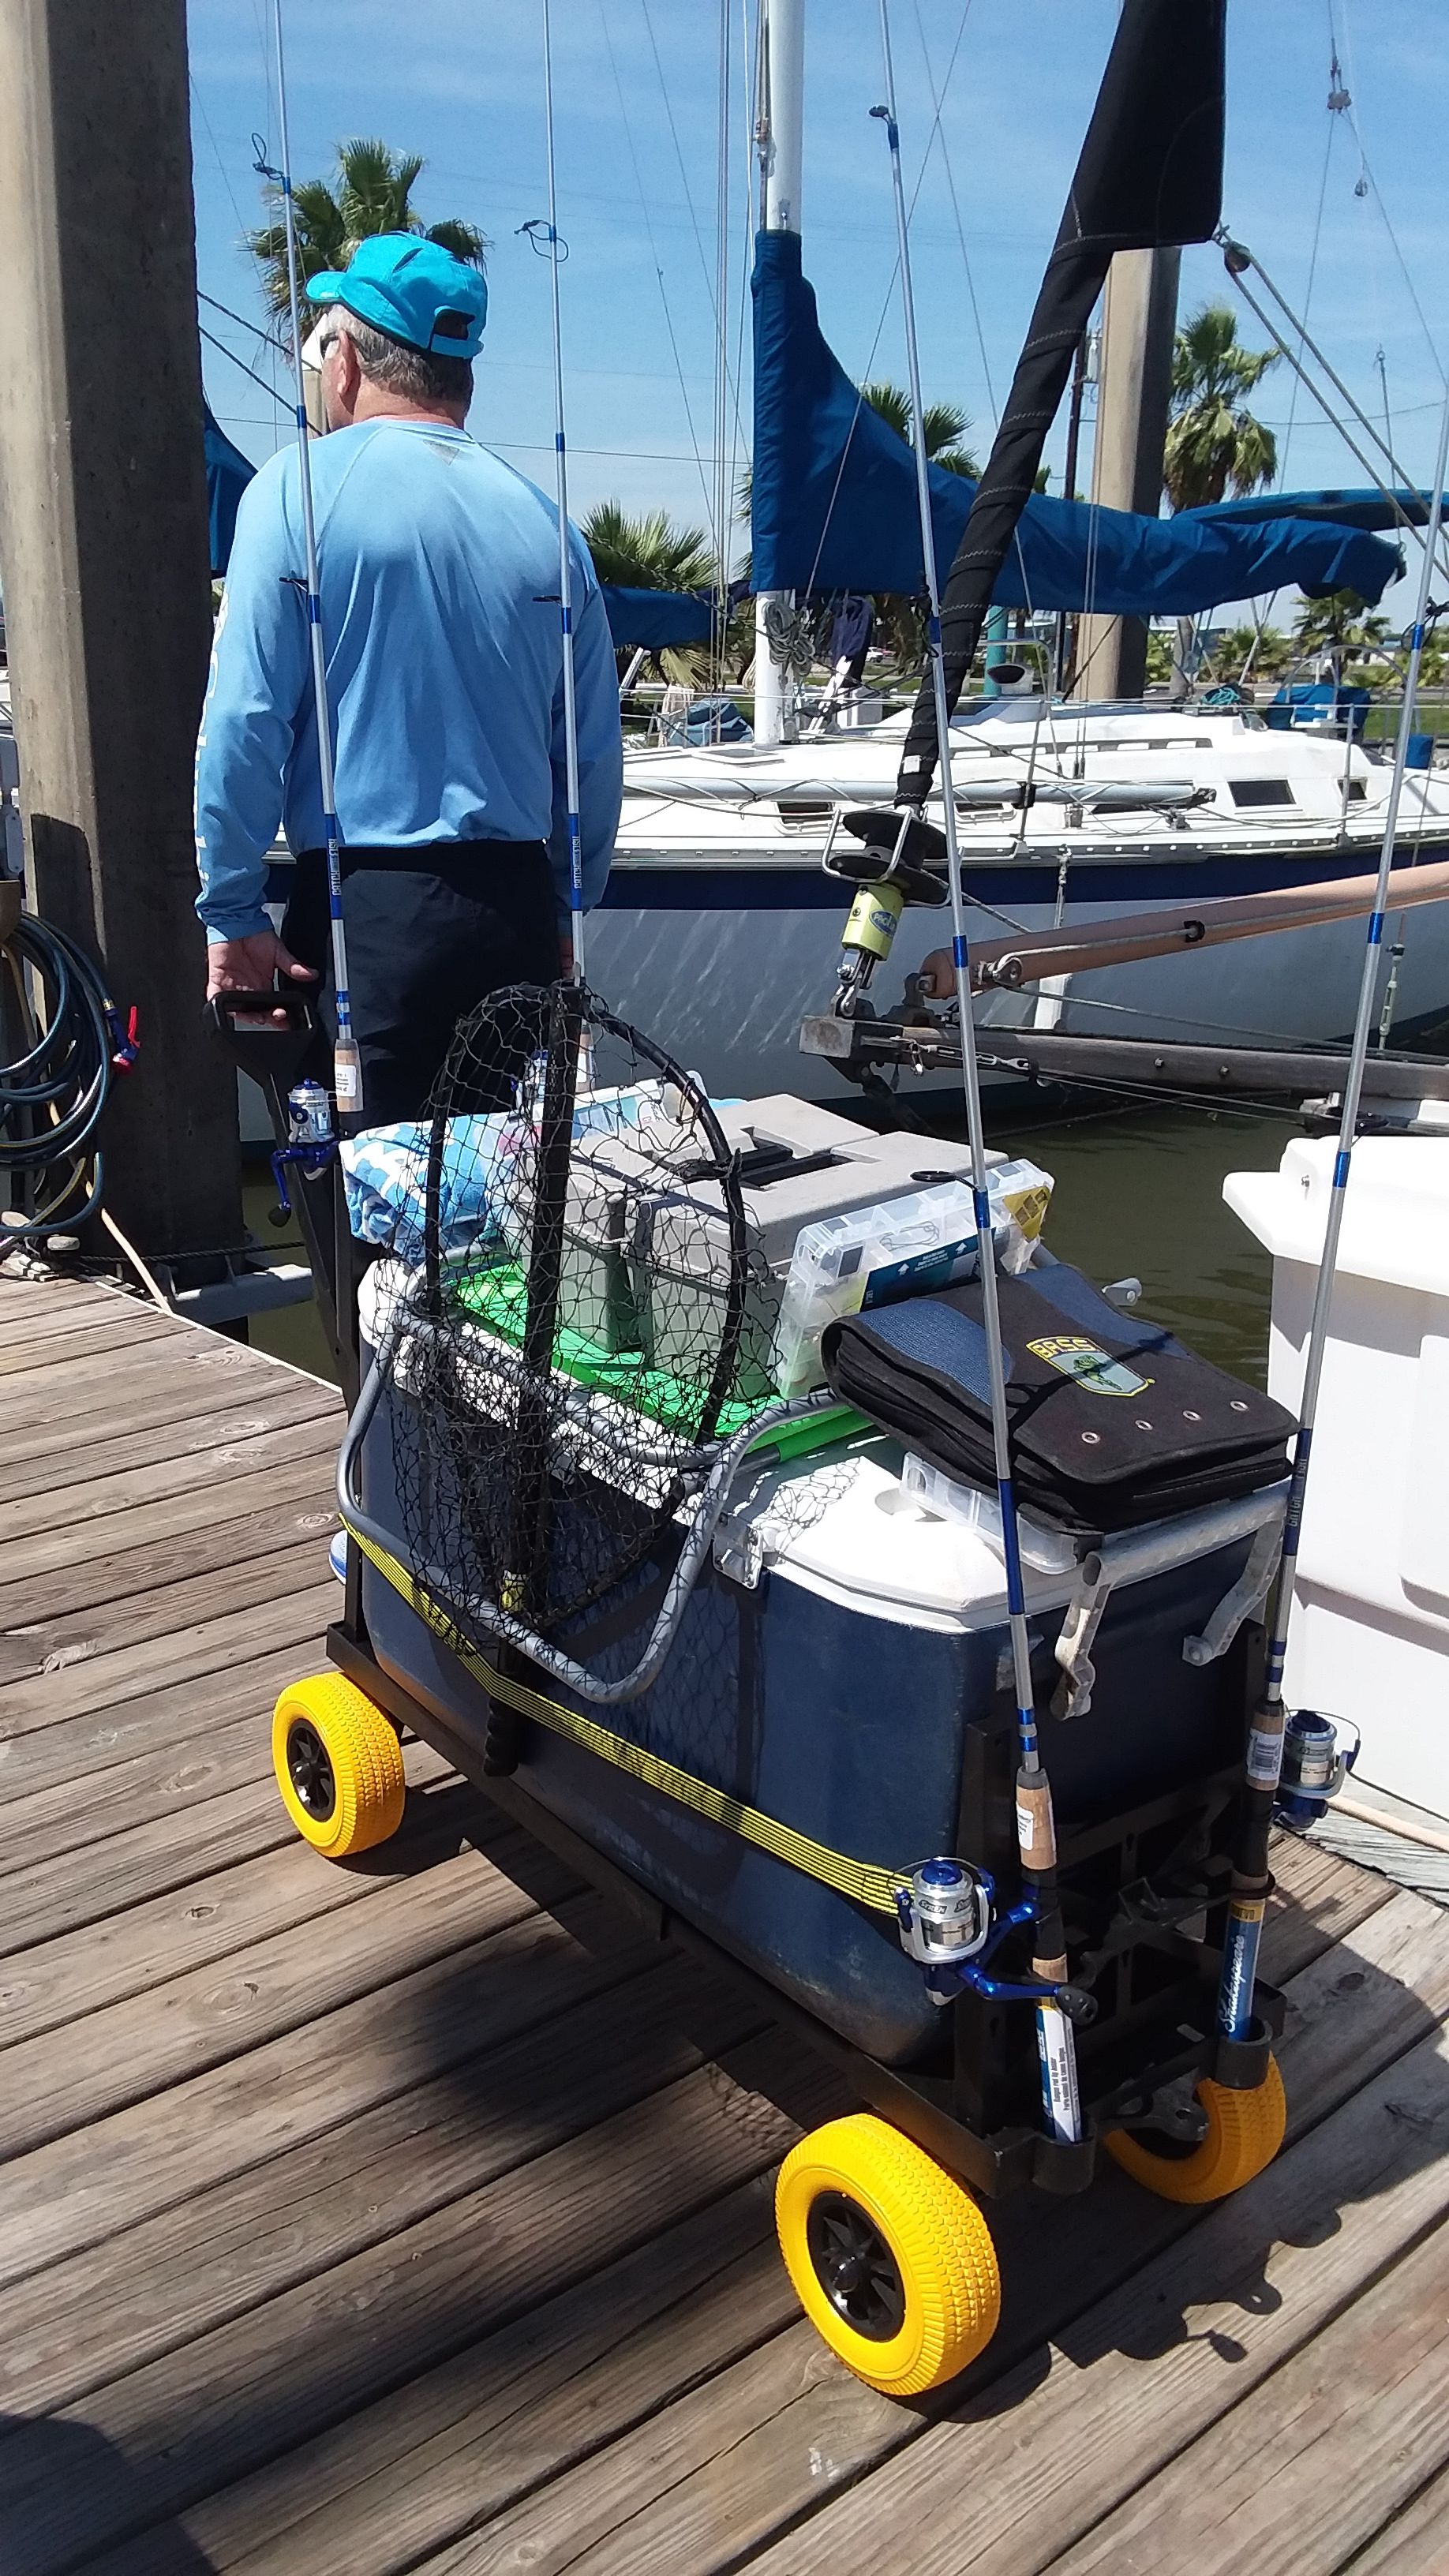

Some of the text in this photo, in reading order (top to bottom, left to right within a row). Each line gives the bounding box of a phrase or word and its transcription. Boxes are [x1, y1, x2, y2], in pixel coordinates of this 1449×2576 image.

[328, 838, 339, 856] FISH
[331, 871, 342, 896] CATCH
[1032, 1339, 1098, 1359] BASS
[1219, 1935, 1245, 2033] Shakespeare
